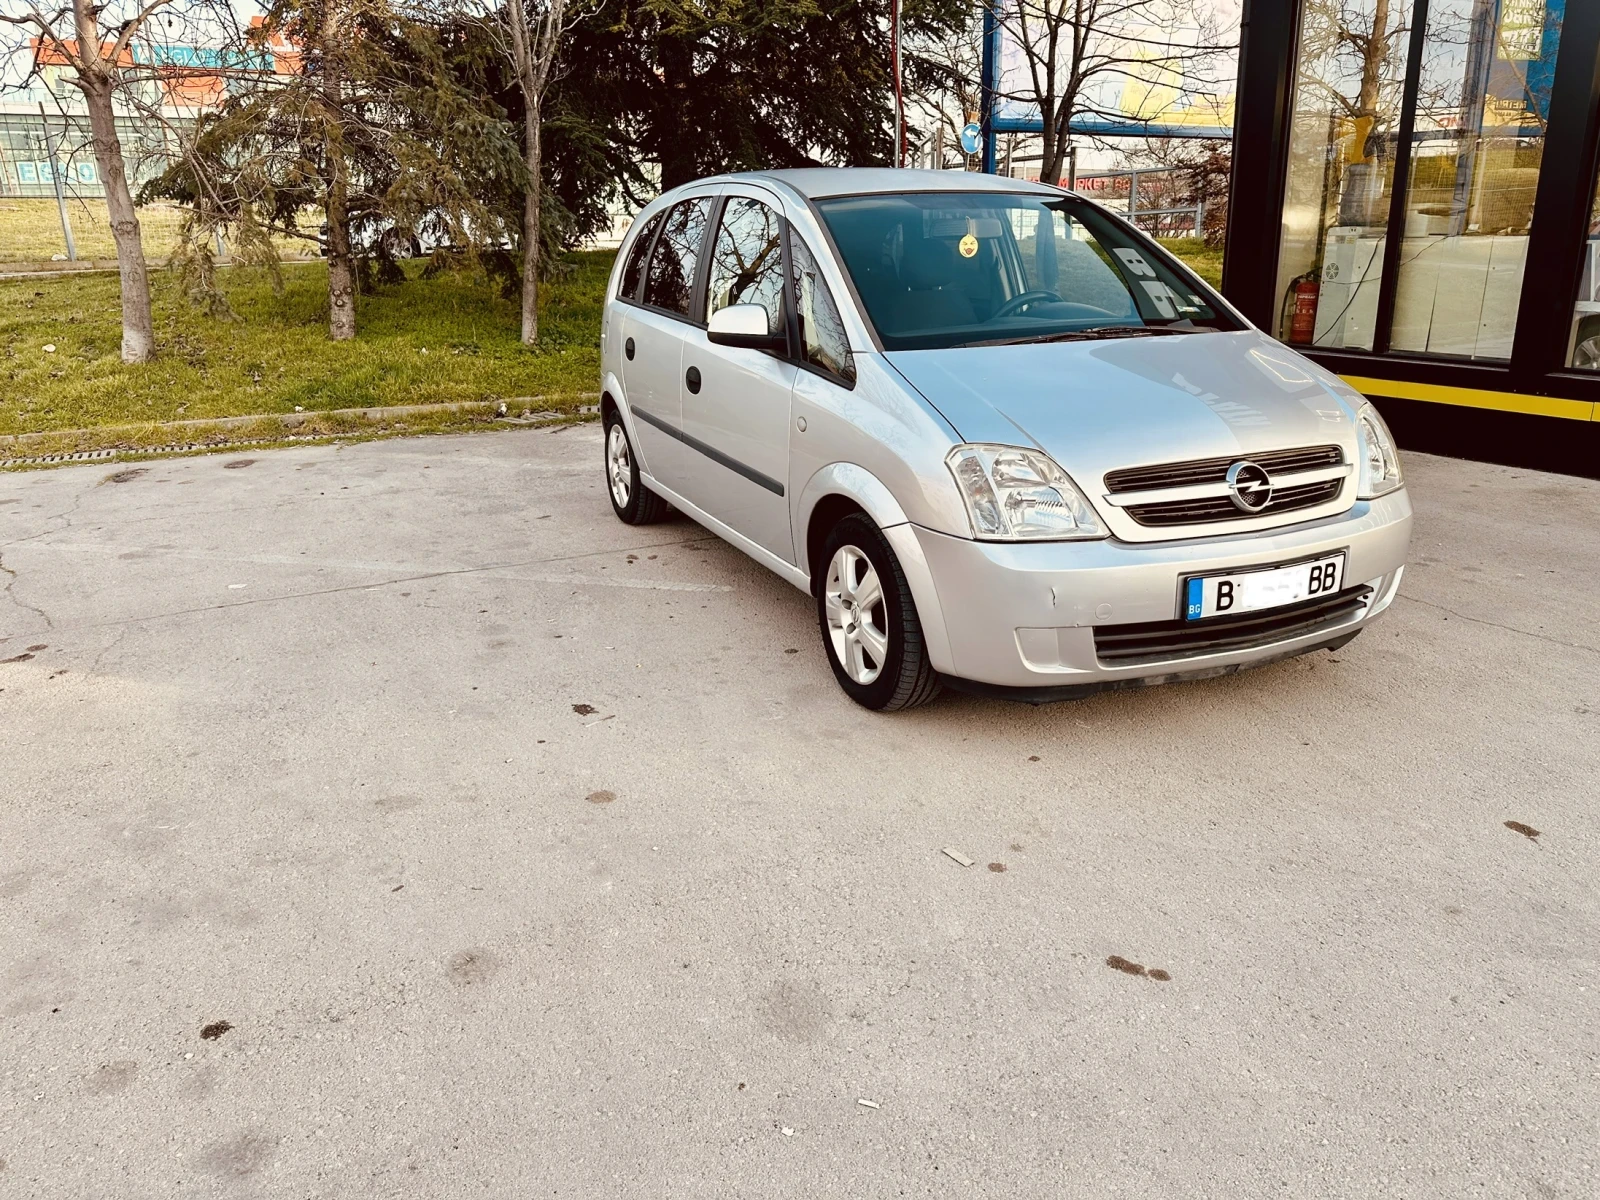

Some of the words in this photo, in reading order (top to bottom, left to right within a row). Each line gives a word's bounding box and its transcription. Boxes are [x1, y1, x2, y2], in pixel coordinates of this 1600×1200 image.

[1057, 178, 1109, 191] MRKET
[1216, 580, 1234, 611] B
[1308, 562, 1336, 595] BB
[1188, 604, 1200, 614] BG
